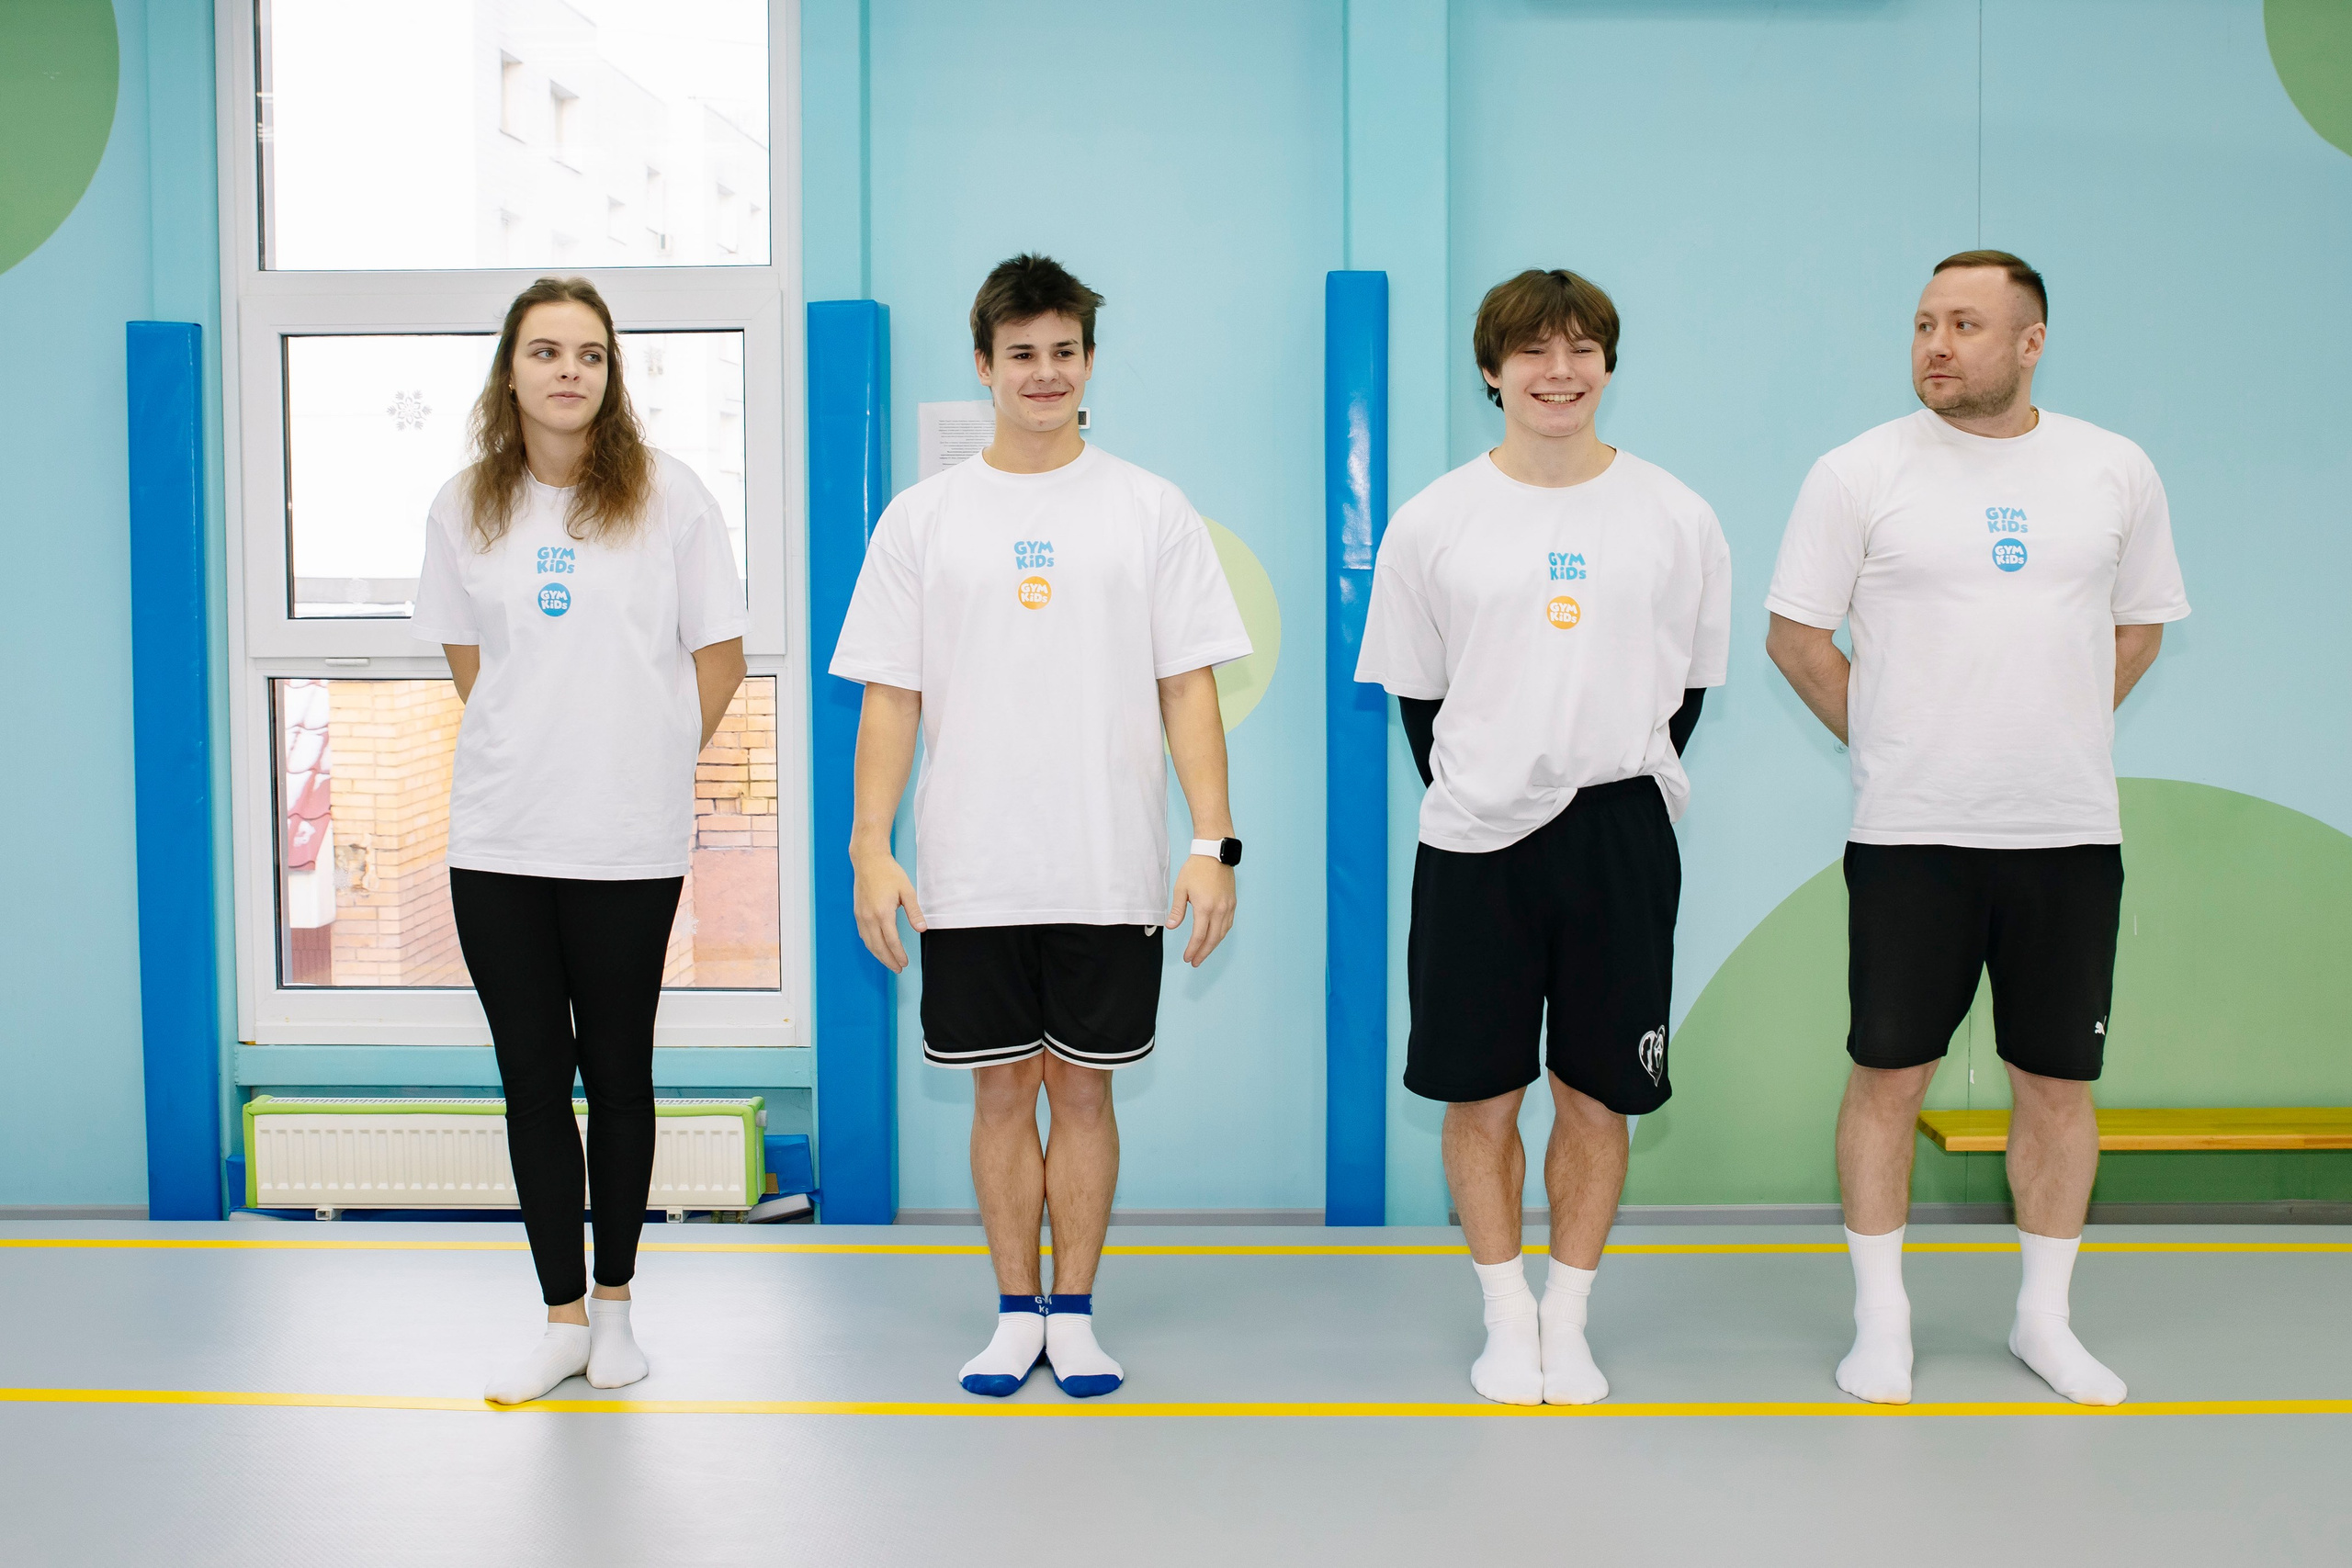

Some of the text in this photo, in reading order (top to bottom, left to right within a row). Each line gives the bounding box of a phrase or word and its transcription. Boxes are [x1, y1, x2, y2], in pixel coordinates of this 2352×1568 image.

[1985, 506, 2027, 521] GYM
[537, 547, 575, 560] GYM
[1014, 540, 1054, 555] GYM
[1995, 545, 2024, 556] GYM
[1548, 551, 1586, 566] GYM
[1021, 582, 1048, 593] GYM
[540, 590, 568, 600] GYM
[1550, 602, 1577, 615] GYM
